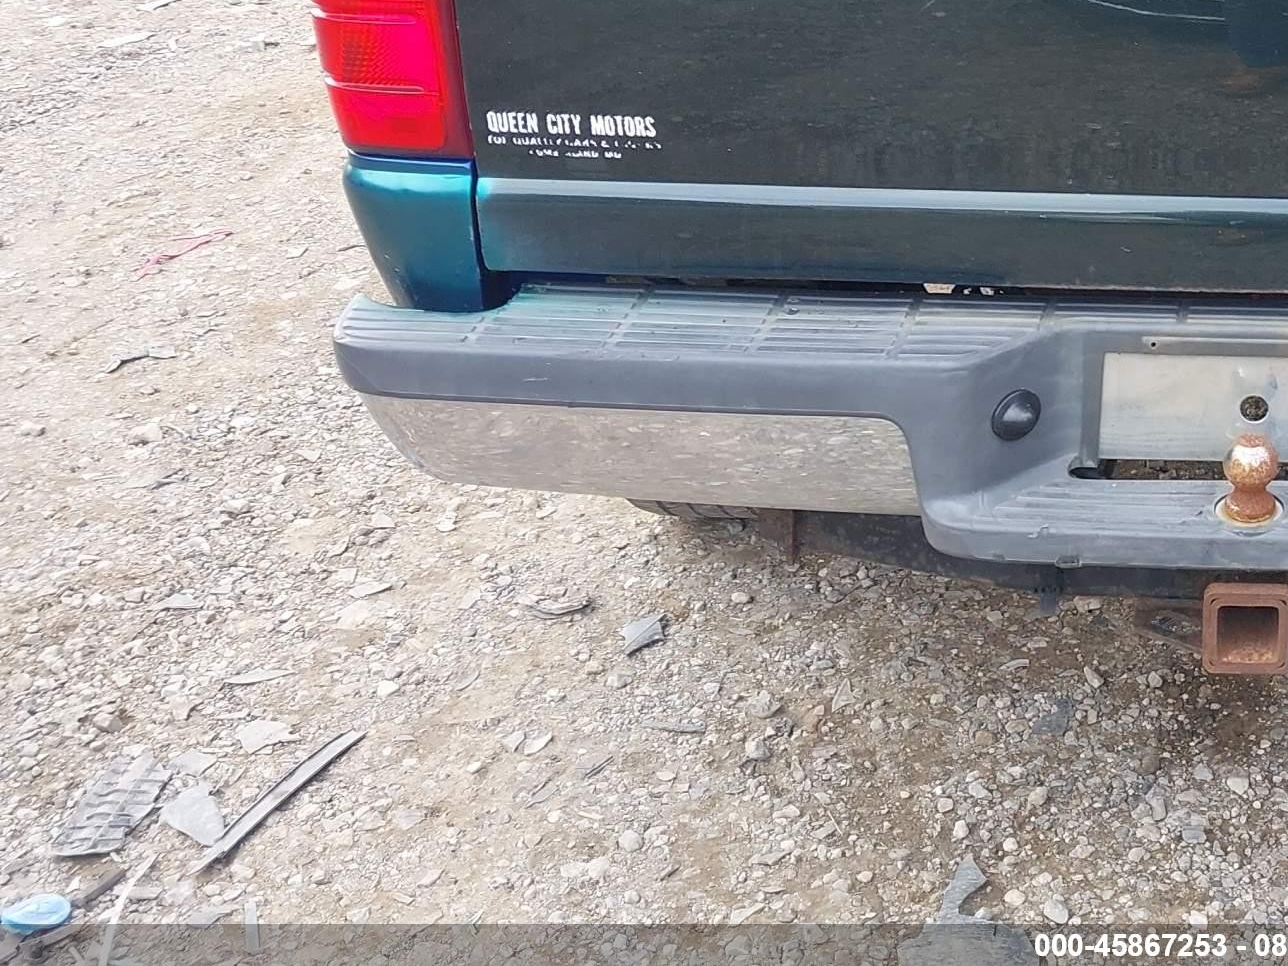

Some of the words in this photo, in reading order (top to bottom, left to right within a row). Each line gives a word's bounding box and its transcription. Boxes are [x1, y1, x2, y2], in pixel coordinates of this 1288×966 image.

[486, 111, 539, 133] QUEEN
[546, 113, 581, 135] CITY
[590, 115, 657, 138] MOTORS
